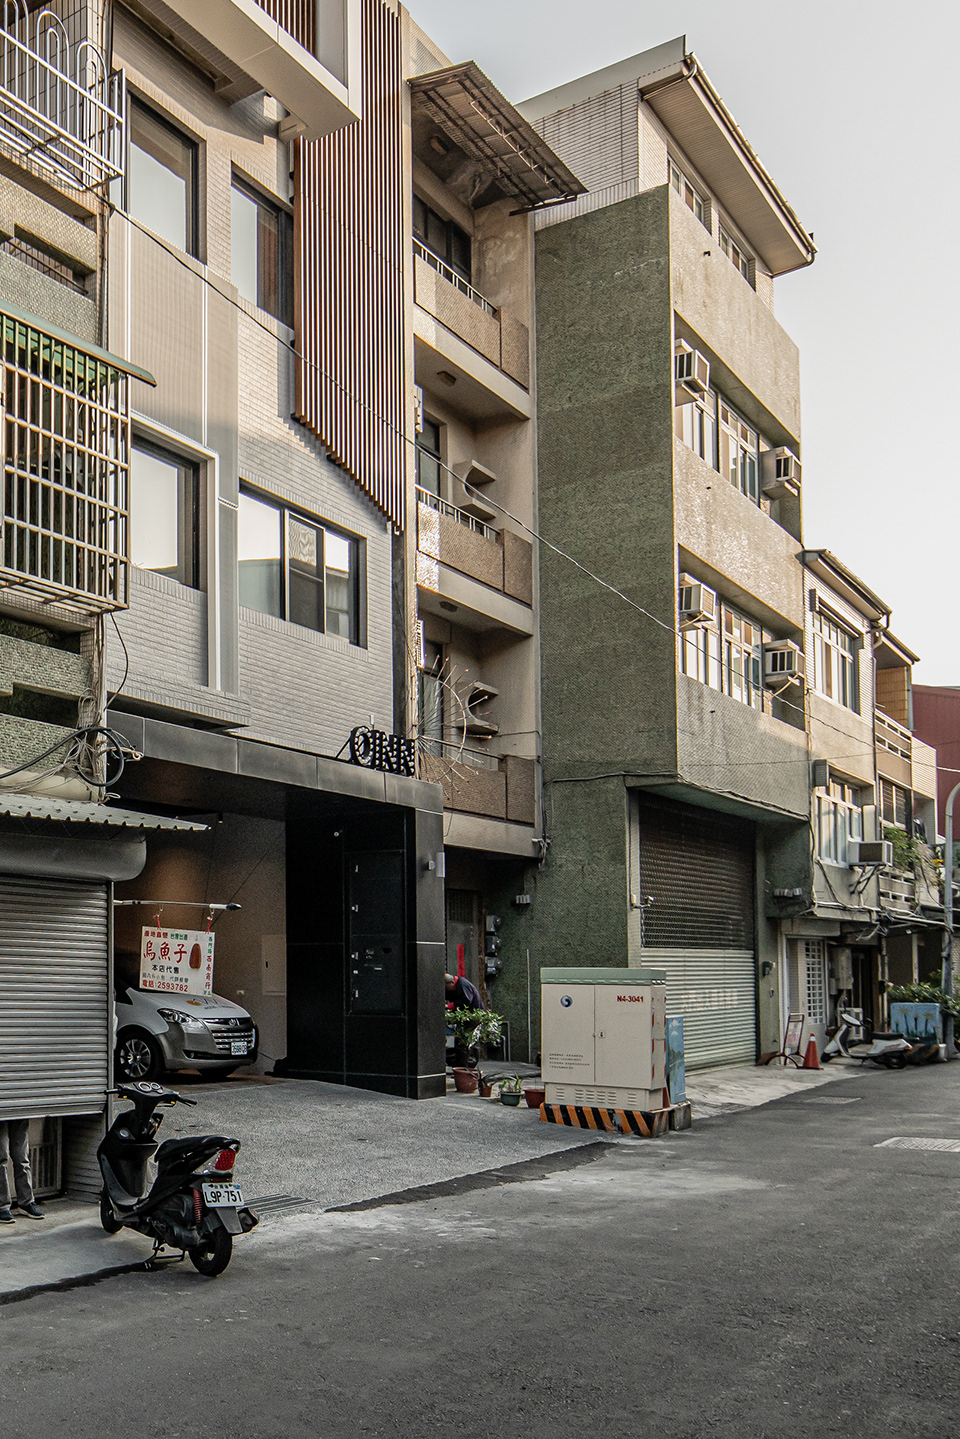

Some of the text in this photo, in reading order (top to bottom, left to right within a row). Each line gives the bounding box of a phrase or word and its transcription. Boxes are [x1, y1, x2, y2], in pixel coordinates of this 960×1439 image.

[143, 940, 188, 964] 烏魚子
[616, 995, 644, 1003] N4-3041
[204, 1190, 242, 1203] L9P-751
